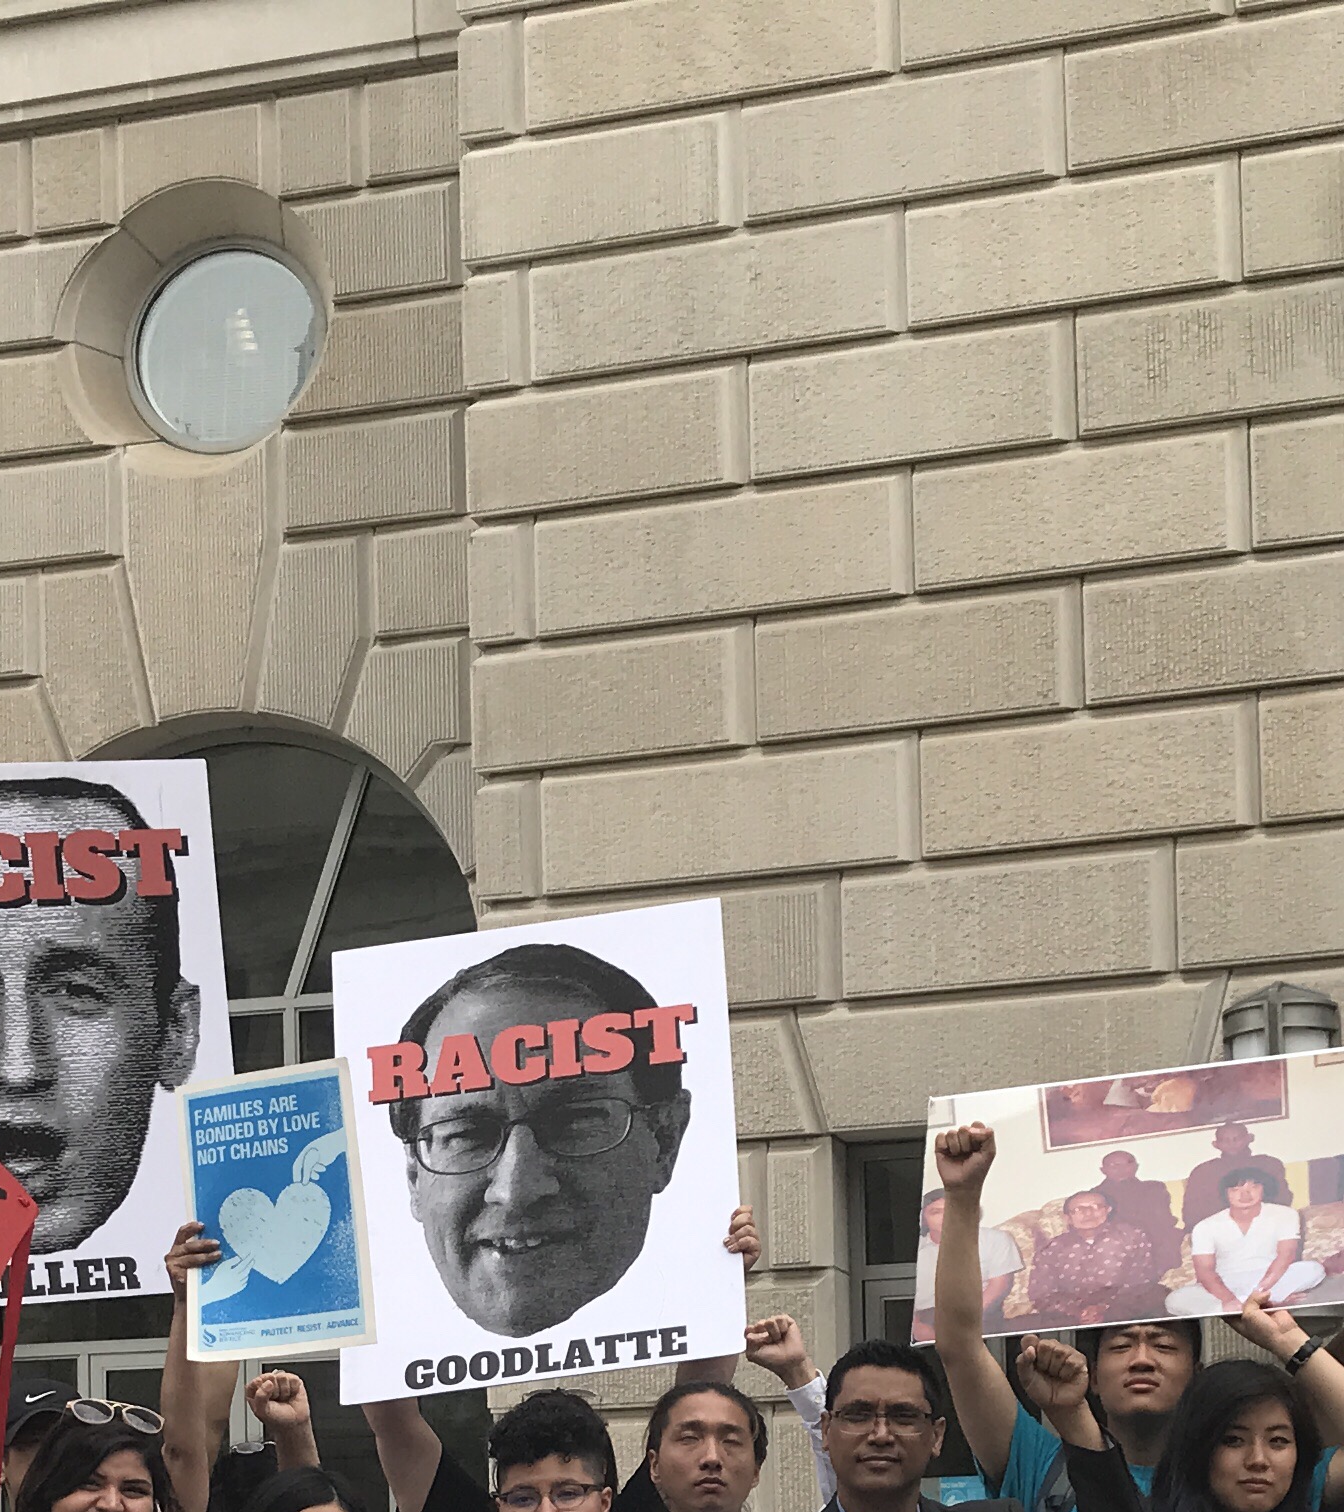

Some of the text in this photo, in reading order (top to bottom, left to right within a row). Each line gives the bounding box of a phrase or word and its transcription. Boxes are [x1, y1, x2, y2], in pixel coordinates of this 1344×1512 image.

[367, 1003, 697, 1105] RACIST
[193, 1094, 299, 1127] FAMILIES ARE
[195, 1111, 321, 1146] BONDED BY LOVE
[197, 1137, 289, 1166] NOT CHAINS
[403, 1325, 689, 1390] GOODLATTE
